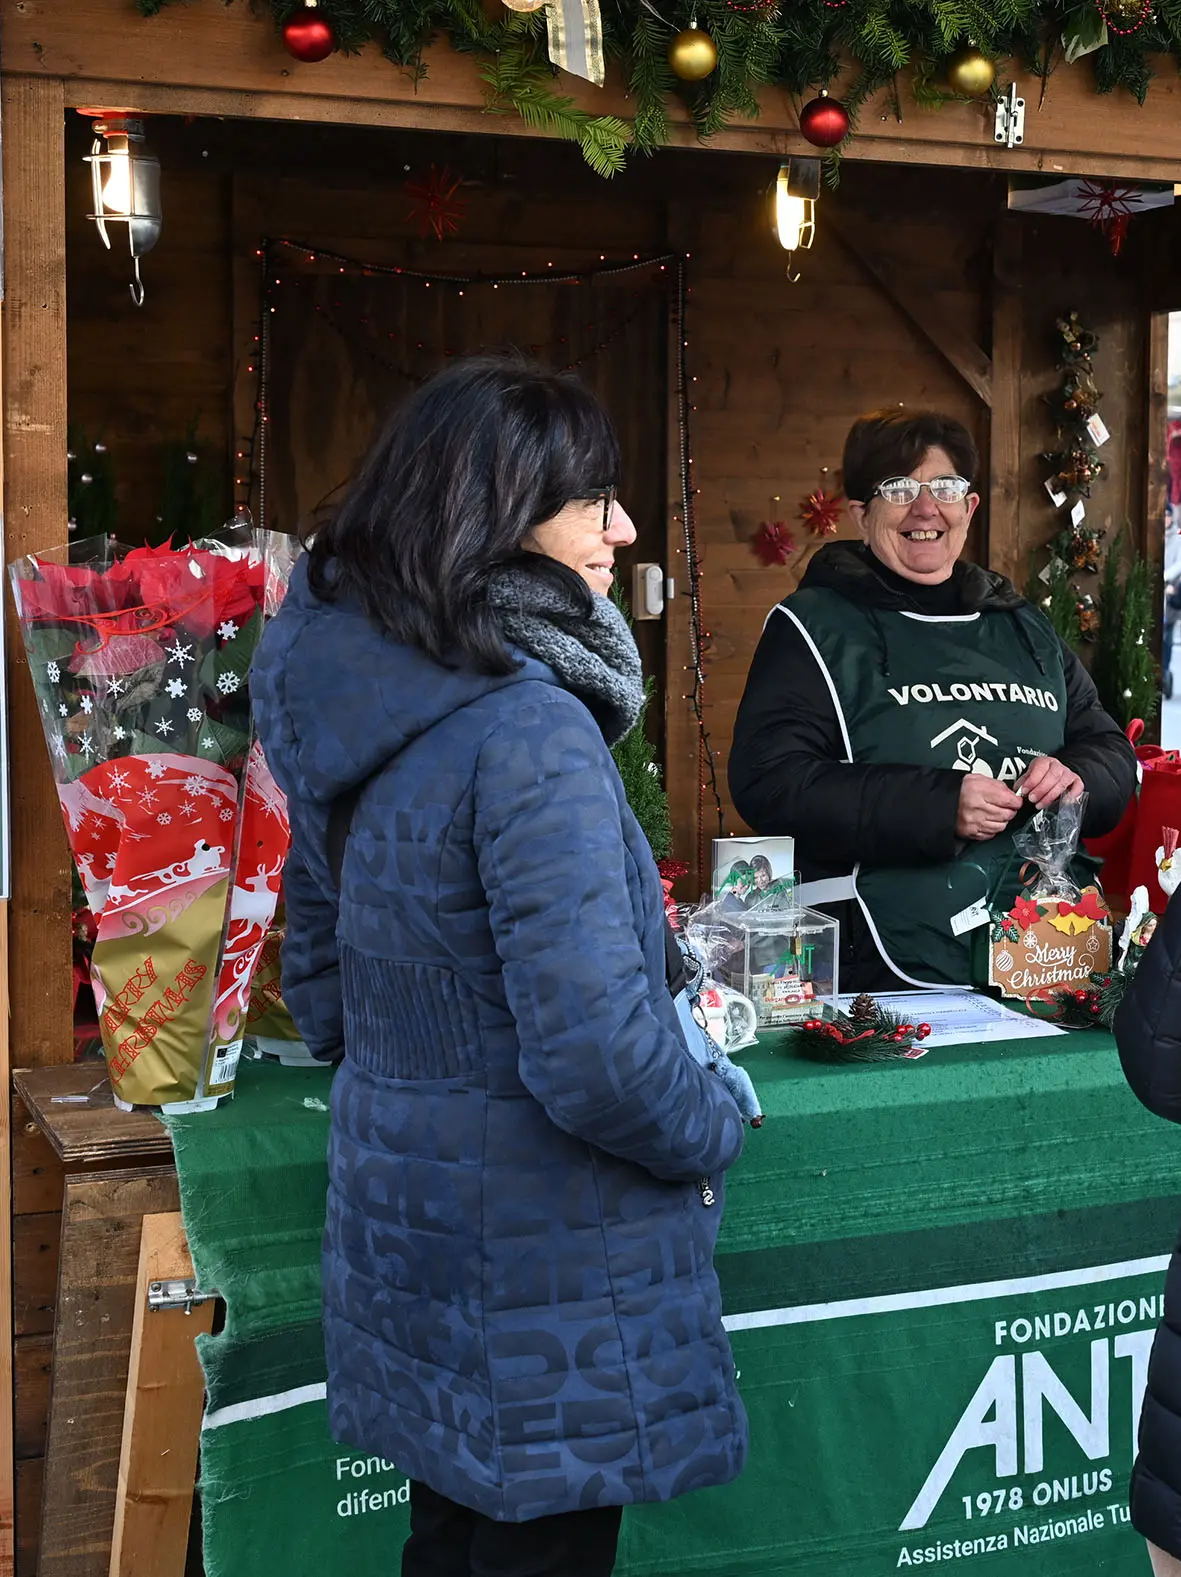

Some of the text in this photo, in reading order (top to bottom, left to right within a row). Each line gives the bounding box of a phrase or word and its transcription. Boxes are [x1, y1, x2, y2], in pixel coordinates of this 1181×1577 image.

[888, 683, 1060, 712] VOLONTARIO
[1007, 953, 1095, 989] Christmas
[1025, 942, 1077, 967] Merry
[337, 1479, 411, 1517] difend
[962, 1468, 1113, 1520] 1978 ONLUS
[896, 1534, 1008, 1568] Assistenza
[1014, 1509, 1104, 1547] Nazionale
